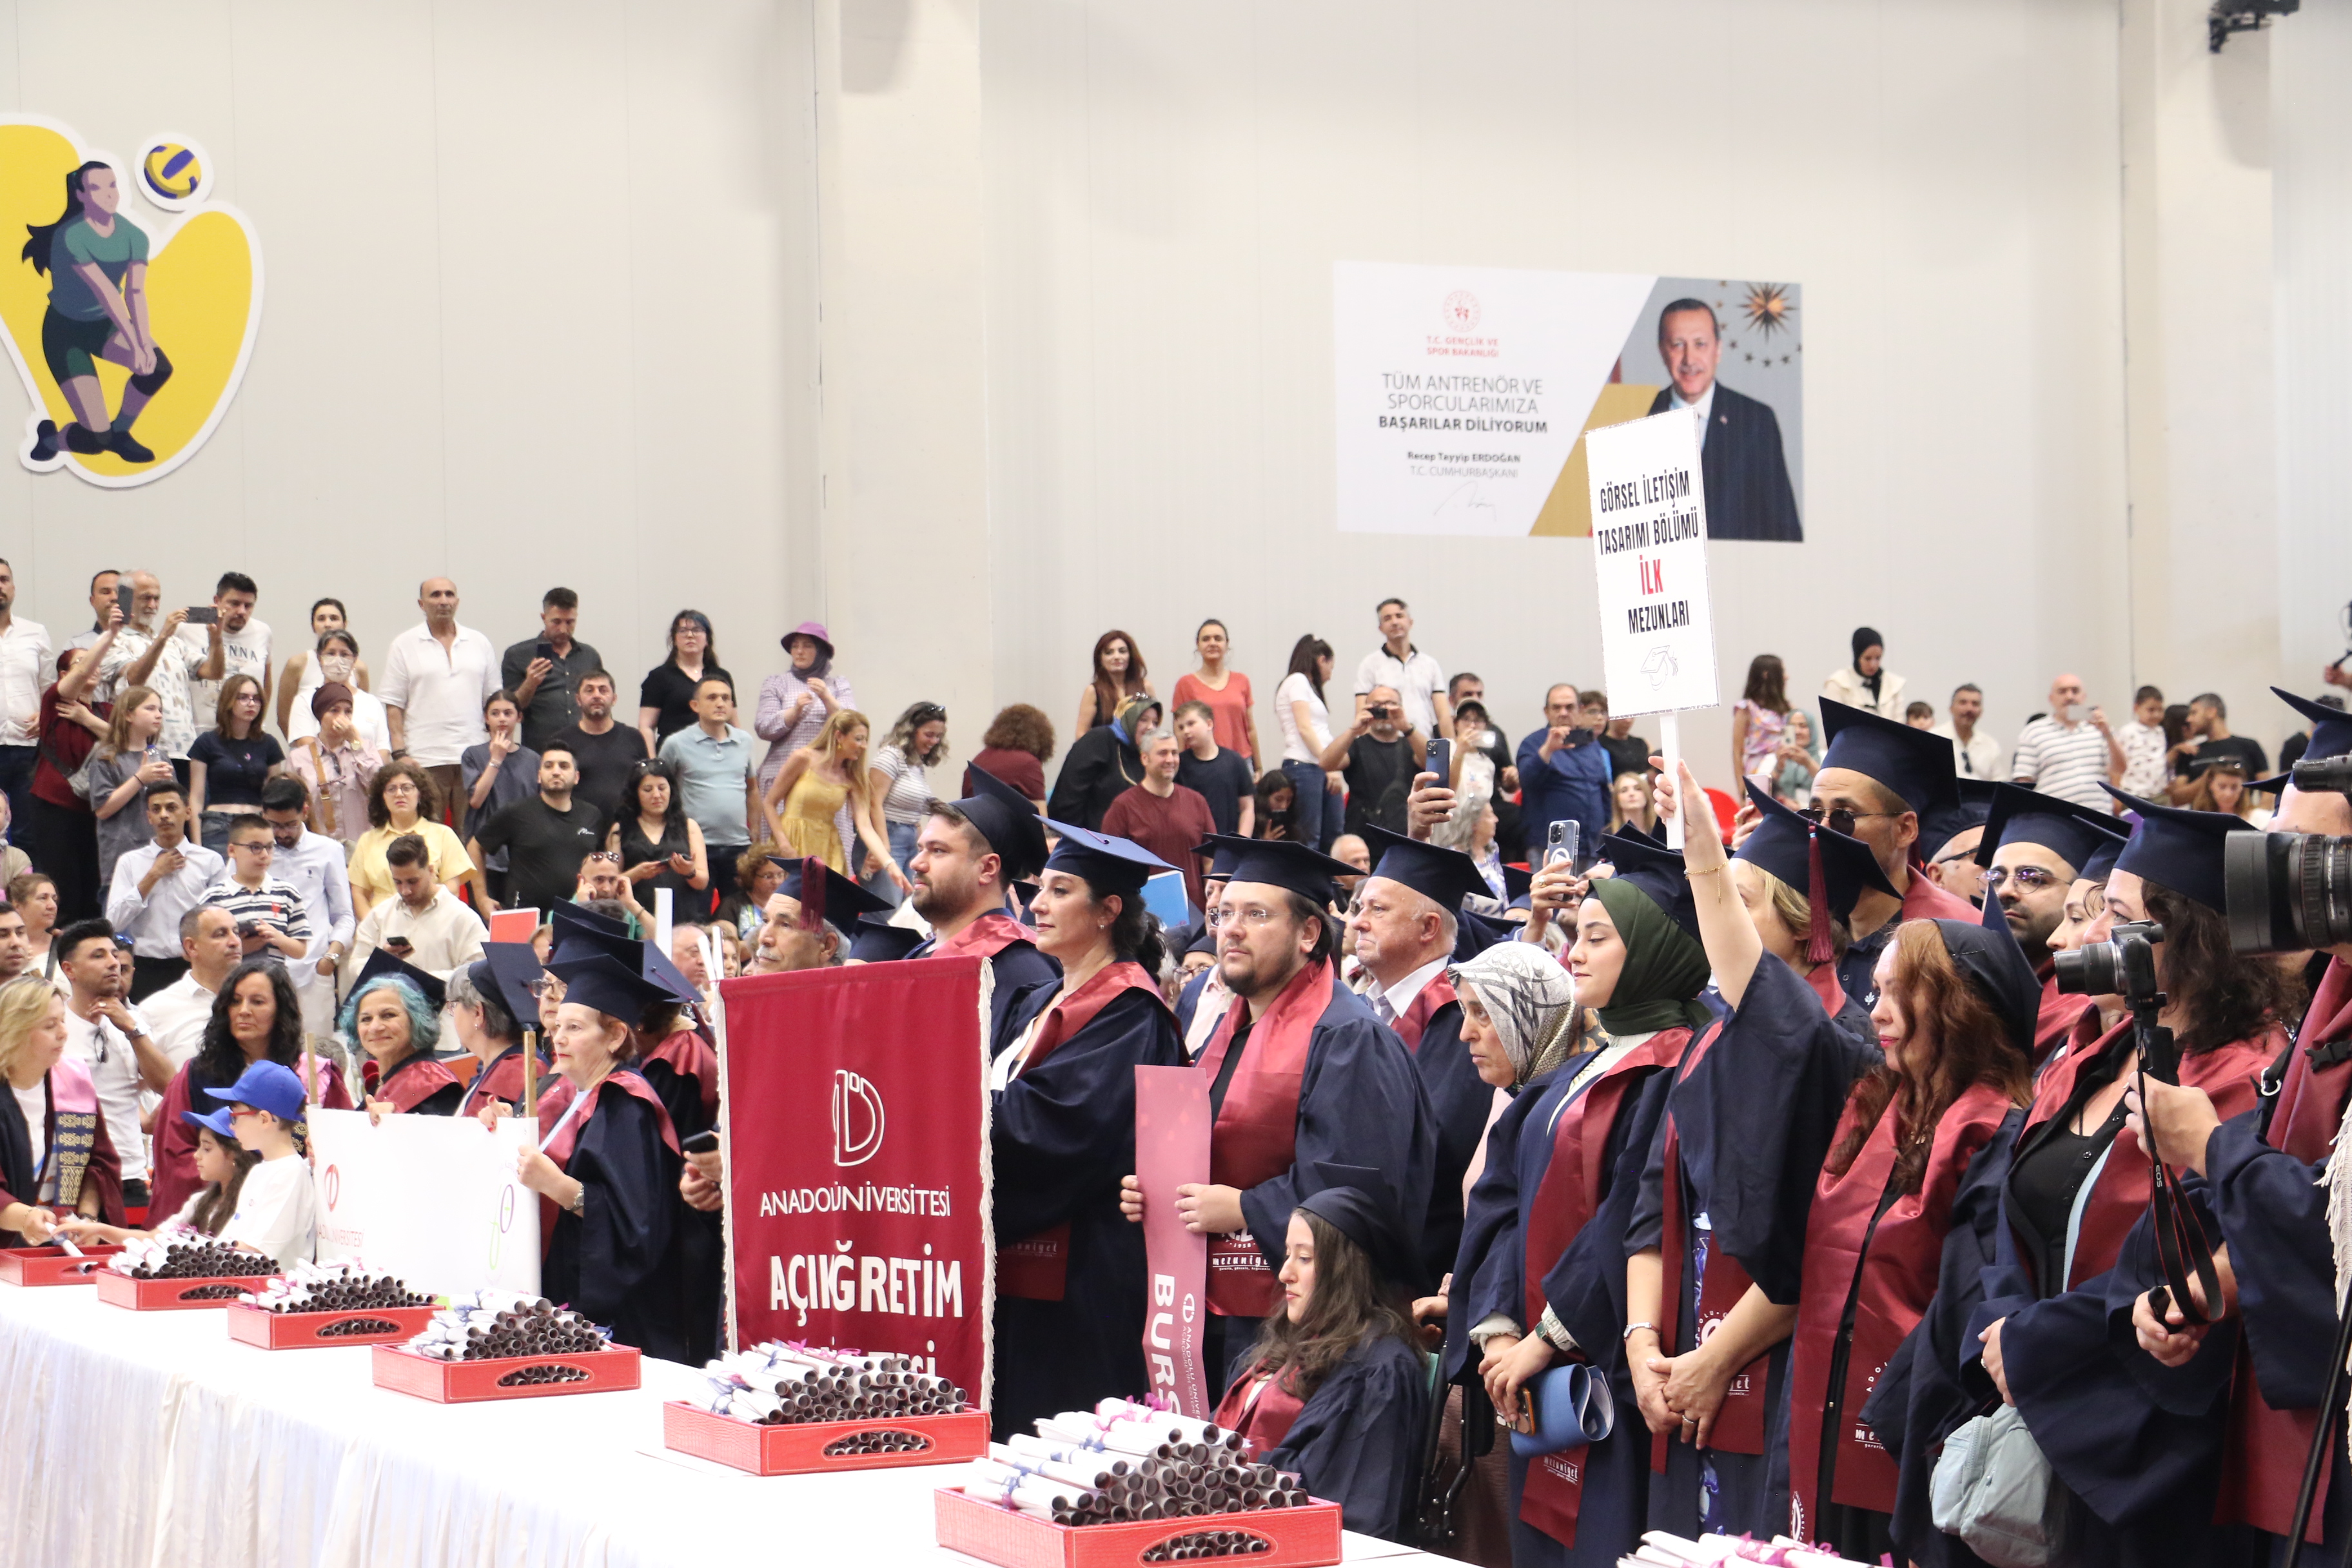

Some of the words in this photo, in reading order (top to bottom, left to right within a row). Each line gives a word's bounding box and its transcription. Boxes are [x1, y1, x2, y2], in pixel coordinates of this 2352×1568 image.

[1427, 347, 1449, 355] SPOR
[1382, 371, 1421, 390] TÜM
[1427, 375, 1519, 395] ANTRENÖR
[1522, 379, 1544, 395] VE
[1388, 393, 1539, 414] SPORCULARIMIZA
[1378, 416, 1462, 432] BAŞARILAR
[1465, 418, 1547, 433] DİLİYORUM
[1408, 451, 1436, 462] Recep
[1438, 453, 1469, 463] Tayyip
[1473, 453, 1521, 463] ERDOĞAN
[1429, 466, 1519, 480] CUMHURBAŞKANI
[1600, 481, 1640, 513] GÖRSEL
[1643, 467, 1690, 508] İLETİŞİM
[1598, 521, 1651, 556] TASARIMI
[1654, 506, 1700, 545] BÖLÜMÜ
[1640, 554, 1664, 596] İLK
[1628, 600, 1690, 634] MEZUNLARI
[1150, 1273, 1182, 1416] BURS
[1184, 1326, 1195, 1380] ANADOLU
